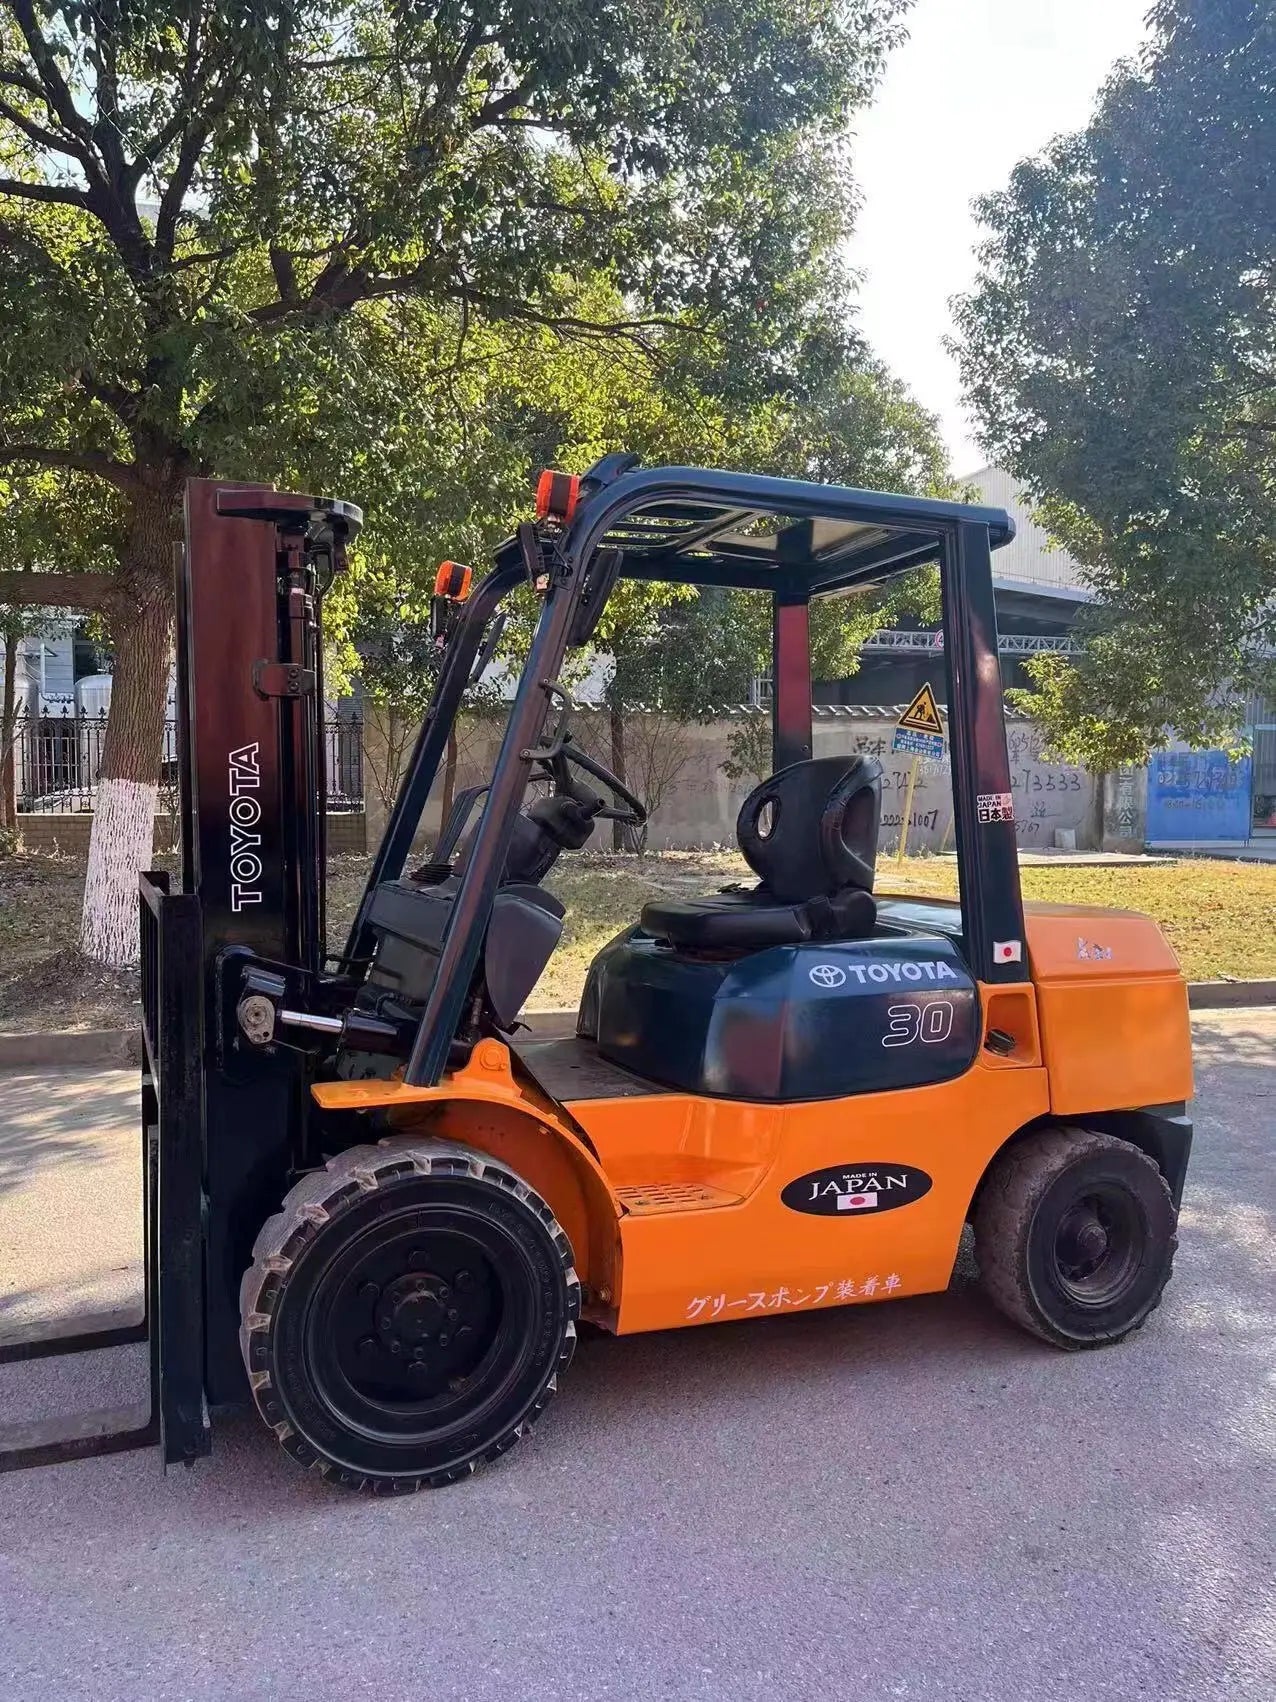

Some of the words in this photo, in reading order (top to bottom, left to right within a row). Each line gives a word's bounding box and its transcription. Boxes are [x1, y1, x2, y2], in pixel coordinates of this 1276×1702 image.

[229, 742, 262, 912] TOYOTA
[979, 807, 1013, 821] 日本製
[849, 961, 957, 984] TOYOTA
[881, 1001, 954, 1048] 30
[809, 1174, 908, 1200] JAPAN
[686, 1272, 903, 1320] グリースポンプ装着車
